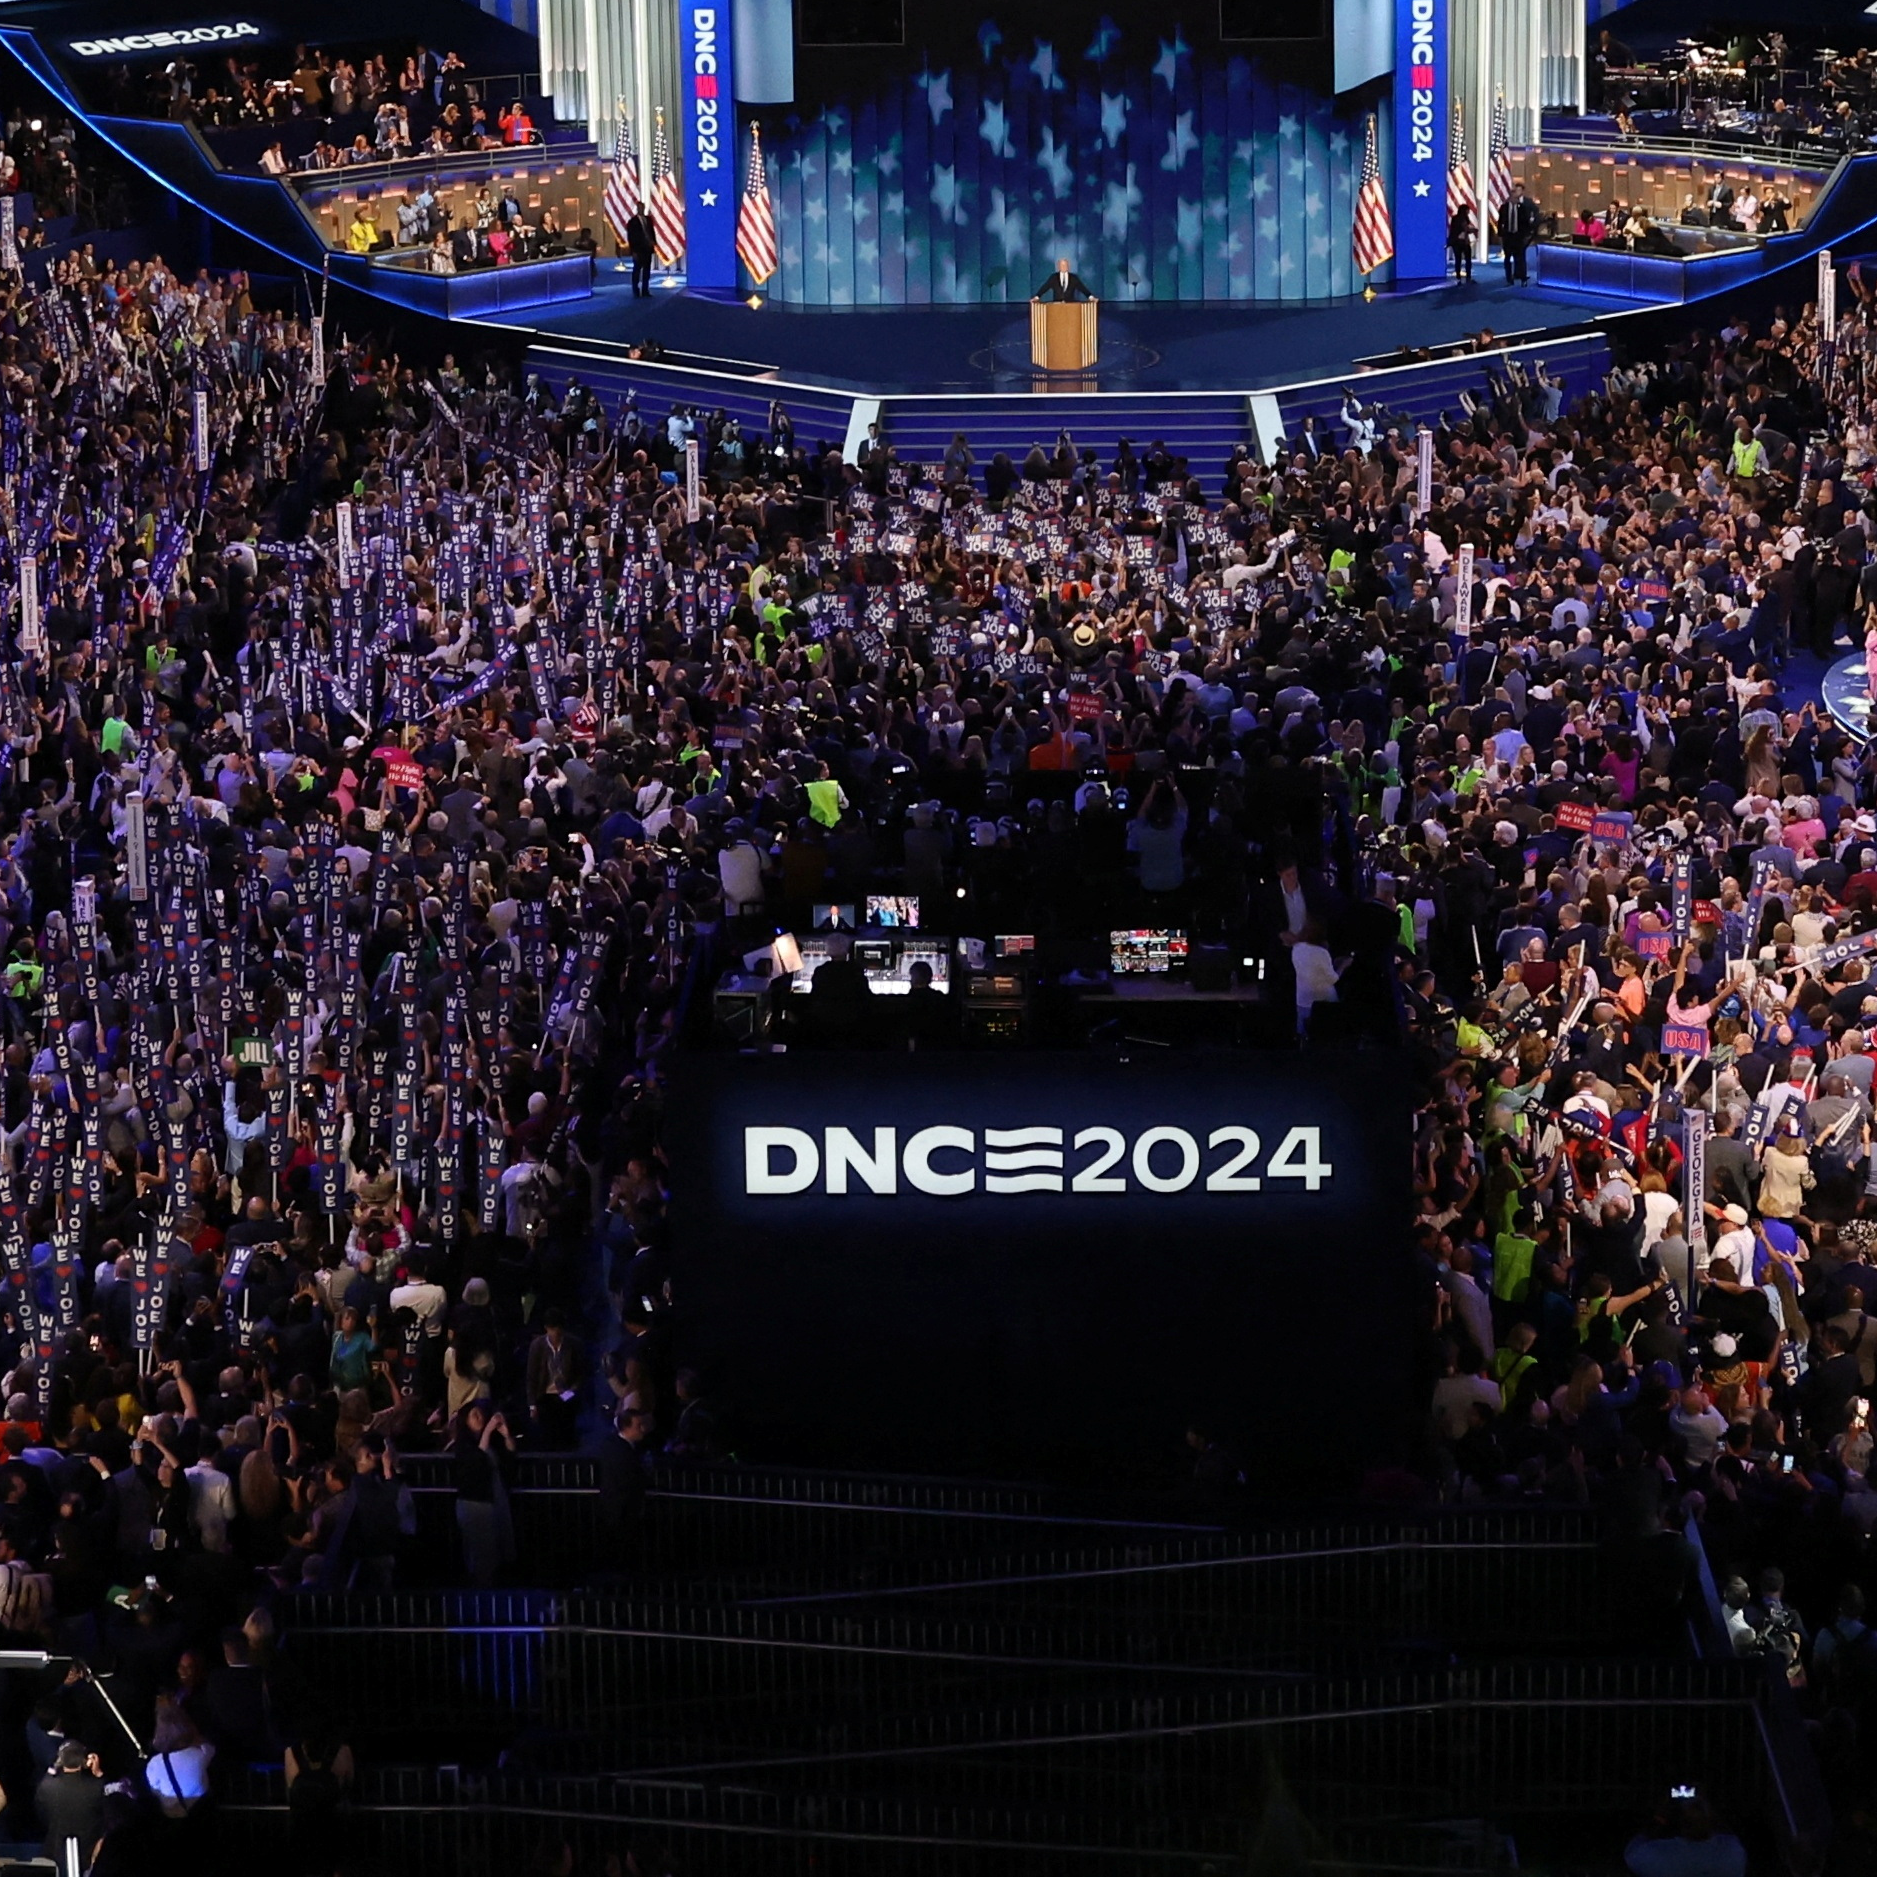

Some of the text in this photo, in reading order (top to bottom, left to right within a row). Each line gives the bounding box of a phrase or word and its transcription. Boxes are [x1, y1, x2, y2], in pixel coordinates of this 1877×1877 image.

[1460, 556, 1471, 622] DELAWARE
[1676, 853, 1691, 931] WE JOE
[239, 1042, 270, 1065] JILL
[1665, 1029, 1702, 1049] USA
[1691, 1131, 1702, 1225] GEORGIA
